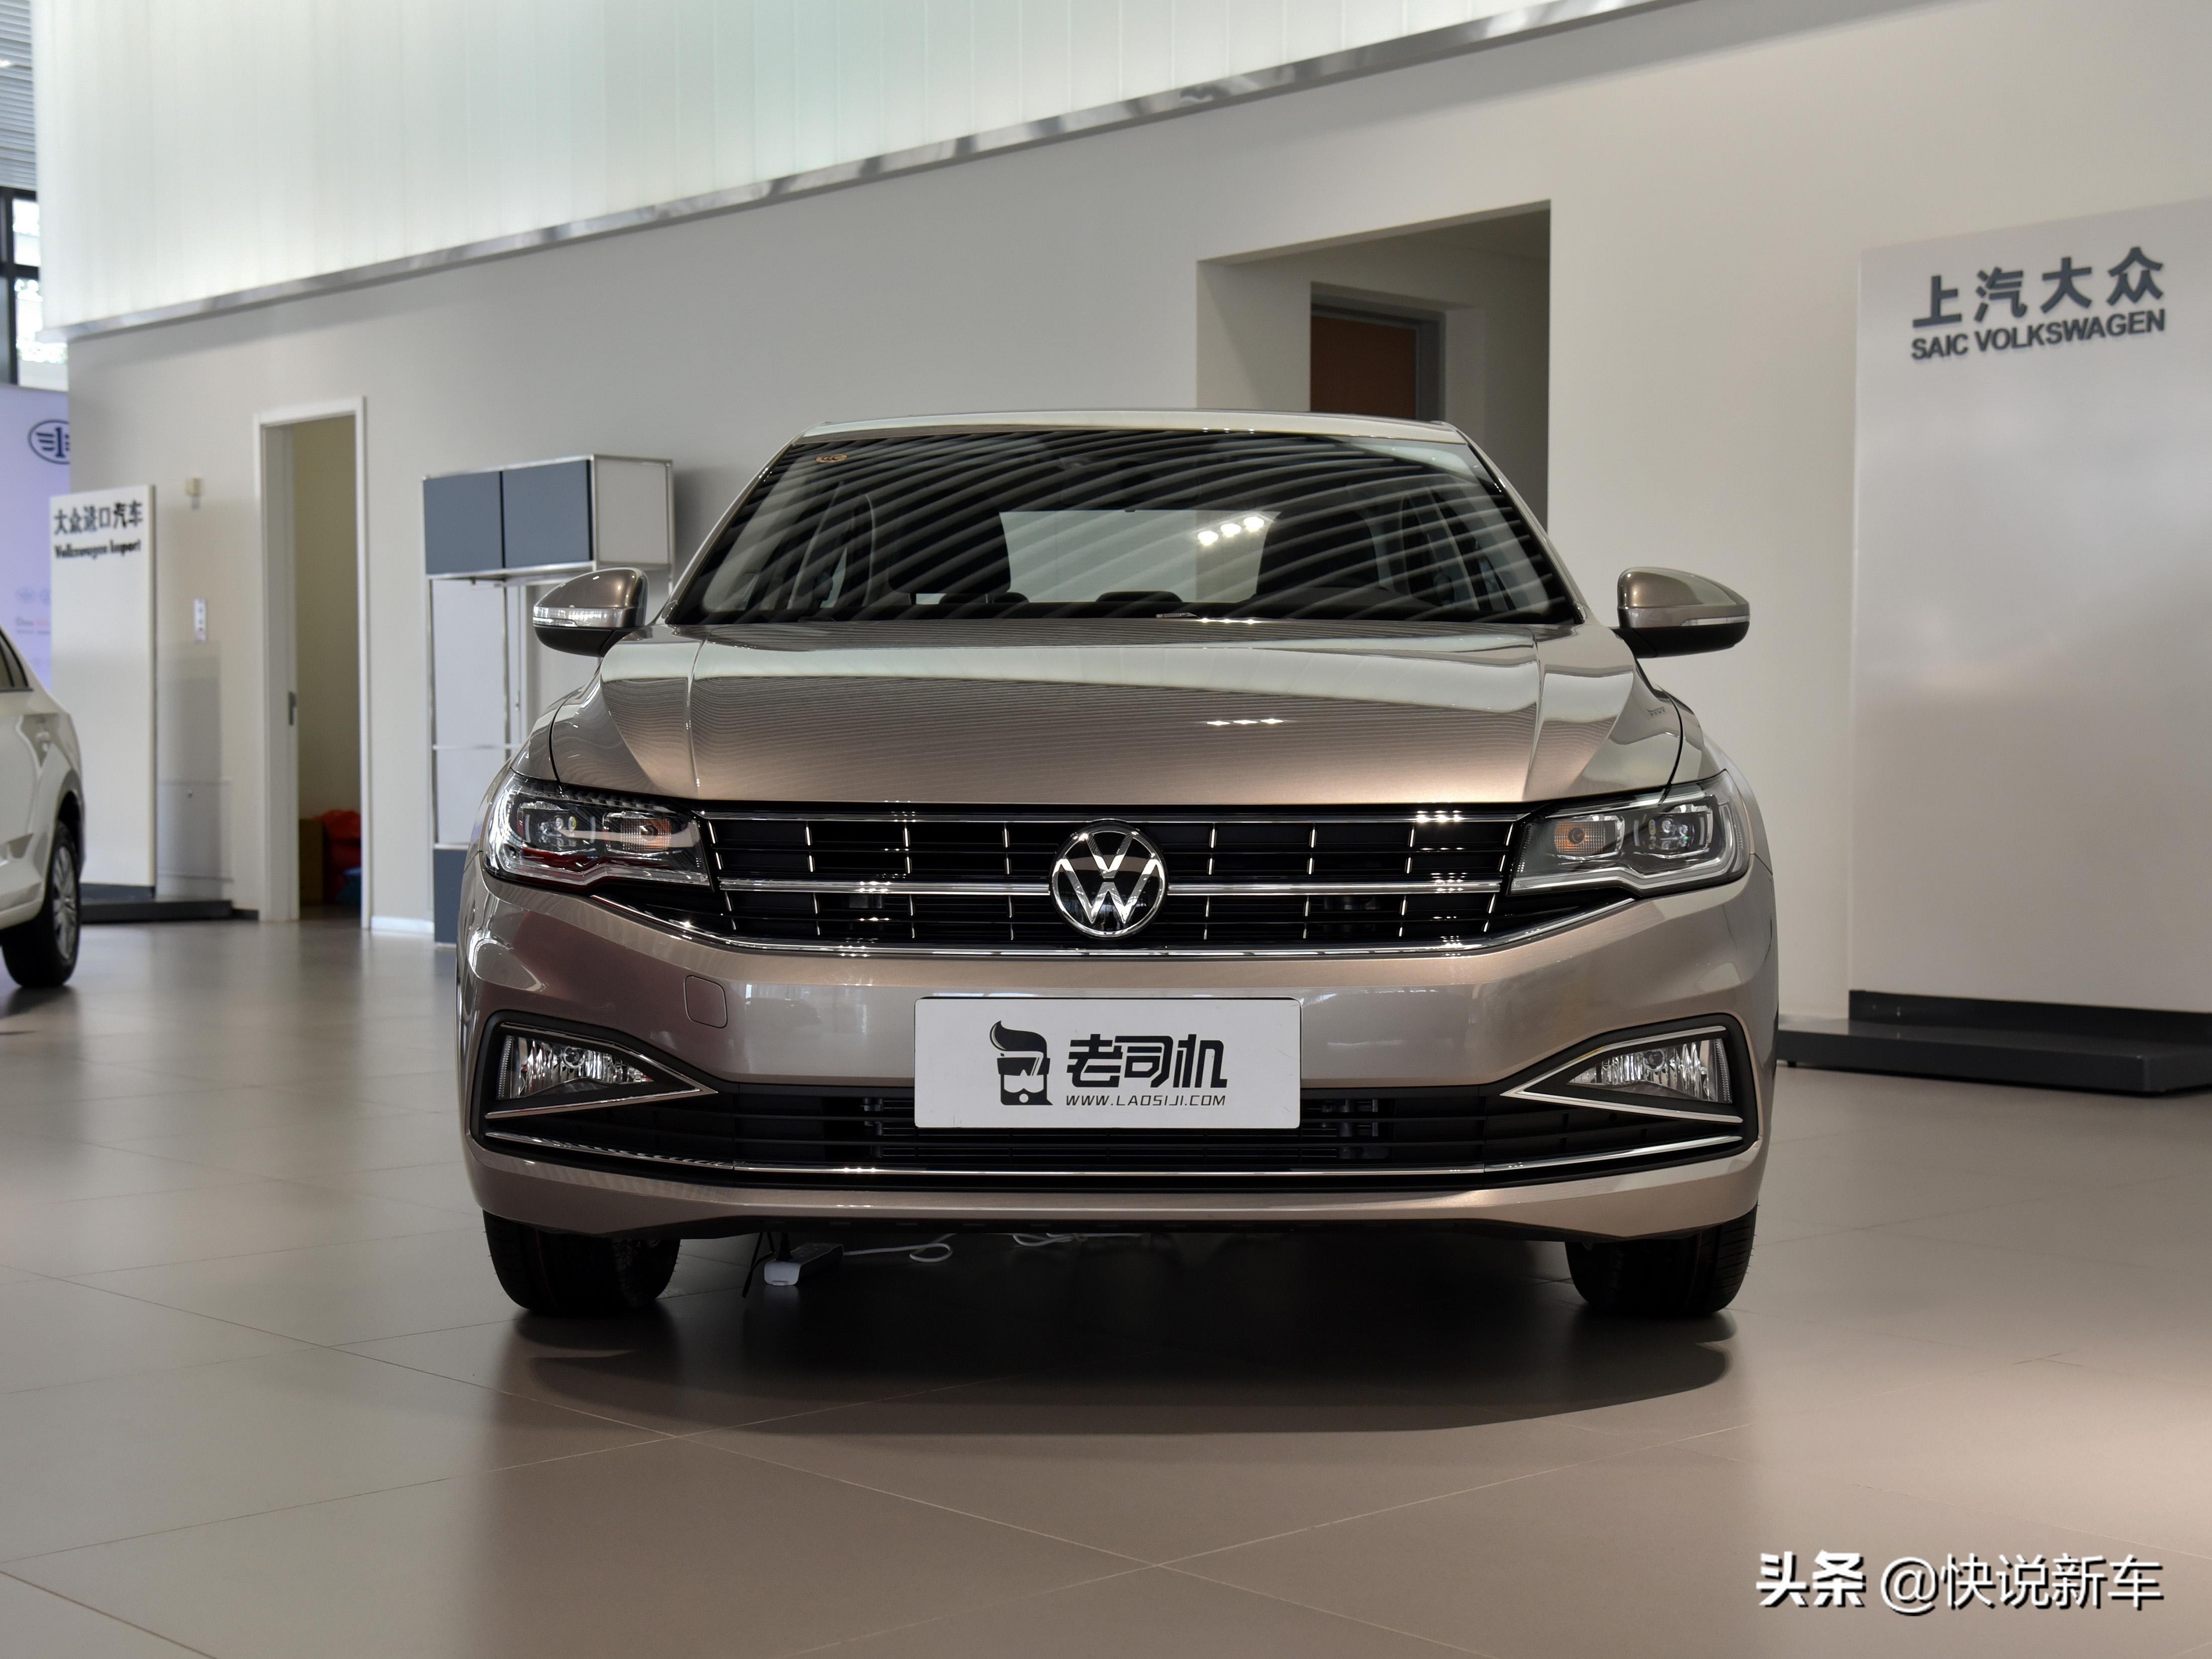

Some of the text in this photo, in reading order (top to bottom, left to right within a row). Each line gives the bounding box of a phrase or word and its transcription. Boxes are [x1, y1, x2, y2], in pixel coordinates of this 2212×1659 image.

[1912, 246, 2164, 329] 上汽大众
[1911, 308, 2166, 360] SAIC VOLKSWAGEN
[54, 500, 143, 535] 大众进口汽车
[1066, 1033, 1228, 1088] 老司机
[1066, 1094, 1226, 1107] WWW.LAOSIJI.COM
